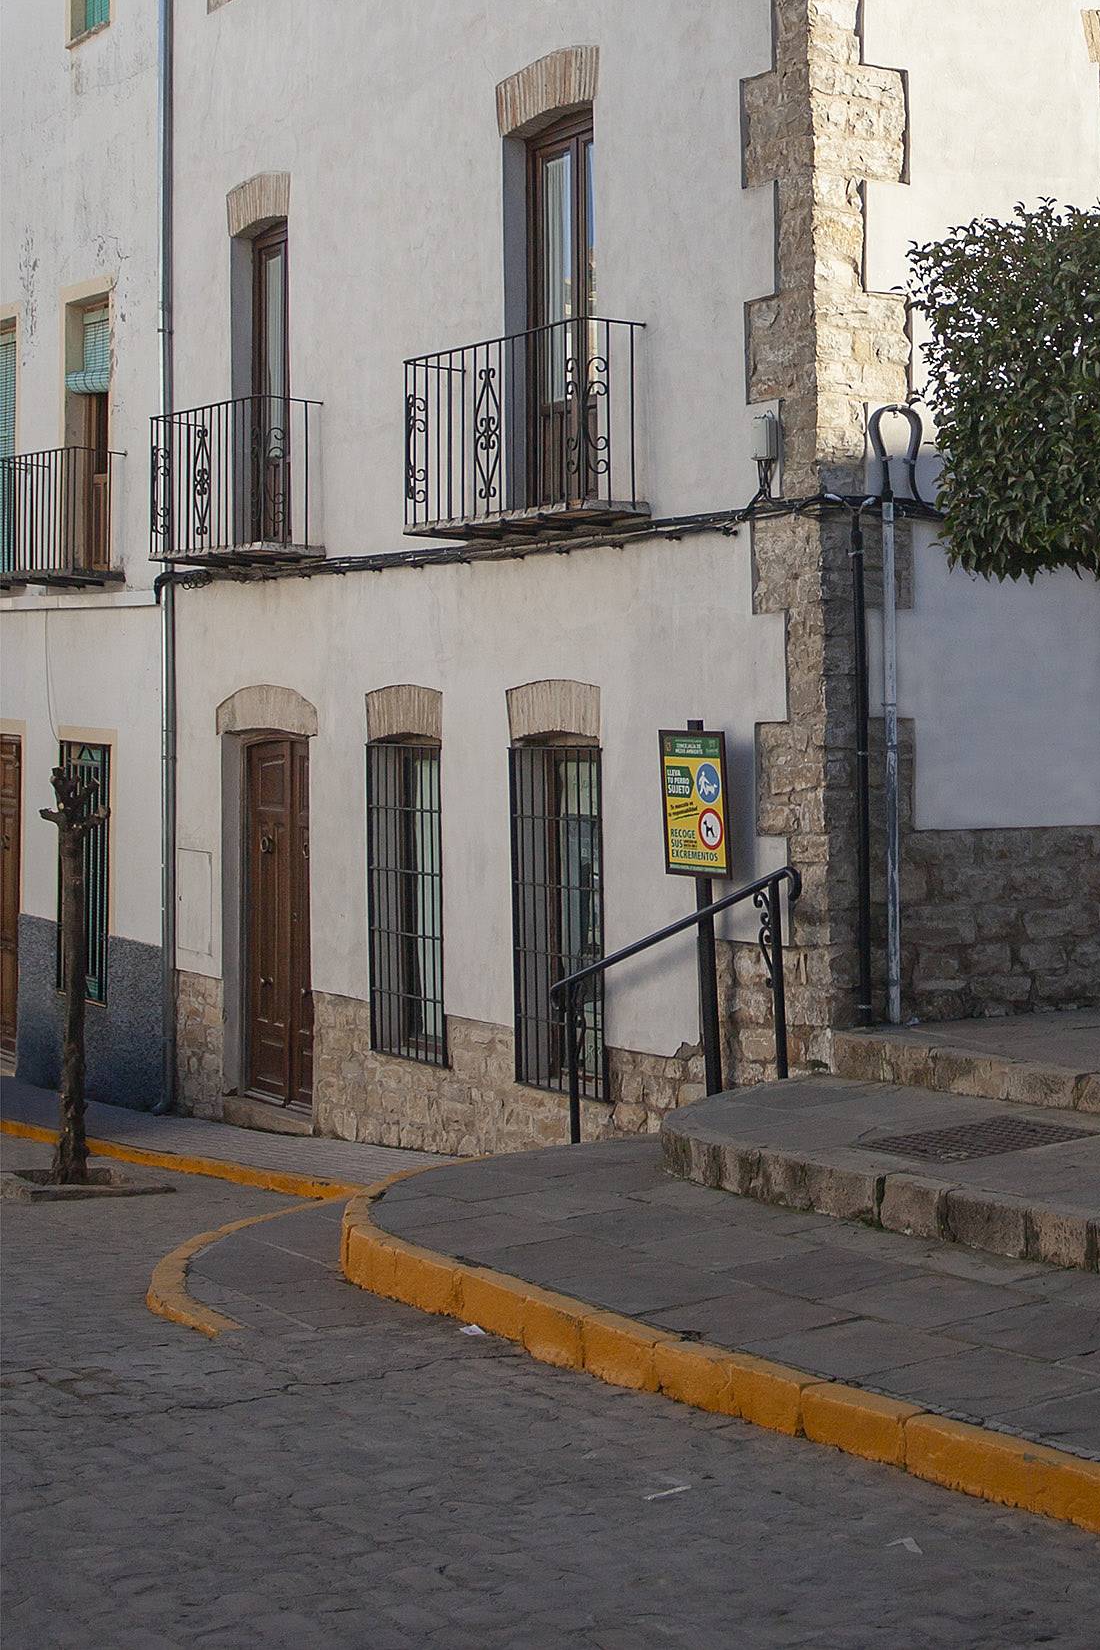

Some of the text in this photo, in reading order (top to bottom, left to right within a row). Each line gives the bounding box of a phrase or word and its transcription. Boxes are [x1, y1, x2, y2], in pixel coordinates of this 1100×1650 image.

[667, 769, 681, 777] LLEVA
[674, 777, 690, 785] PERRO
[668, 784, 690, 795] SUJETO
[670, 828, 696, 839] RECOGE
[671, 839, 683, 848] SUS
[671, 849, 719, 862] EXCREMENTOS
